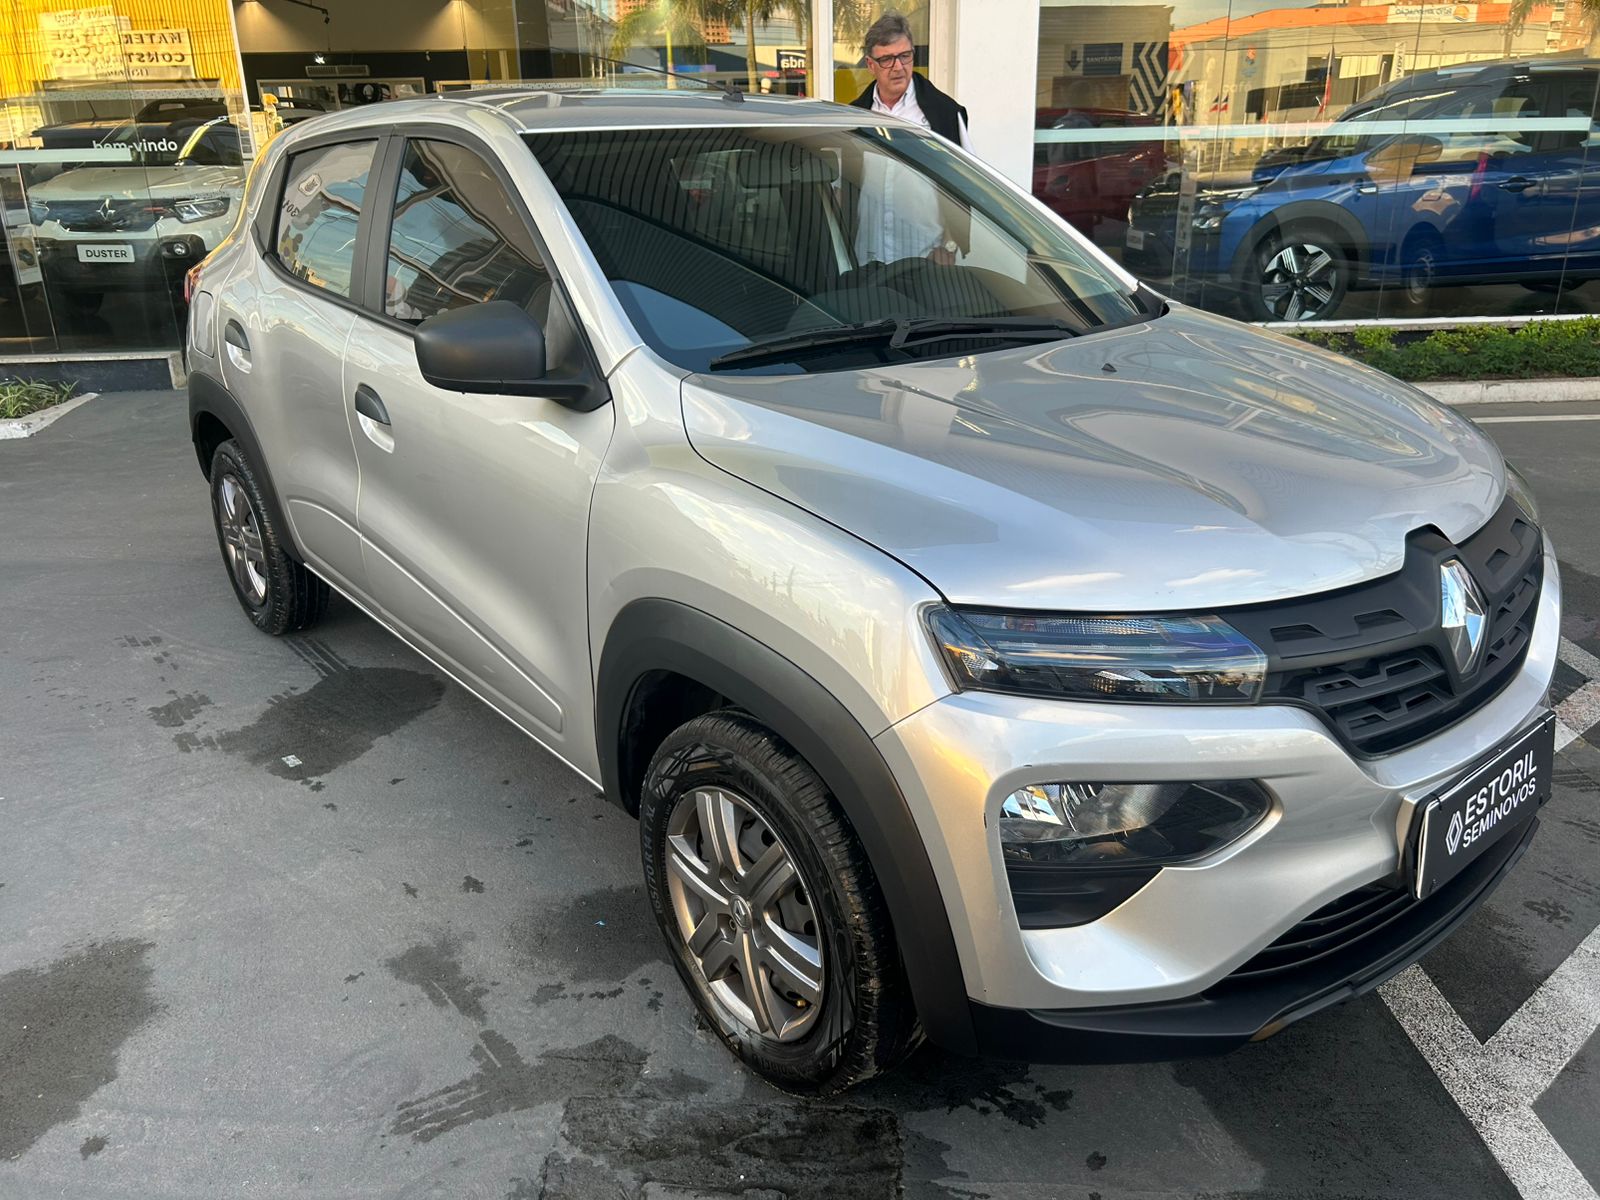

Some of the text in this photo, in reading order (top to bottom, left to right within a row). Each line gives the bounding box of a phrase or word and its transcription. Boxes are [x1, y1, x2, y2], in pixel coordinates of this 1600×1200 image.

[93, 138, 178, 151] bem-vindo
[85, 249, 128, 259] DUSTER
[1465, 750, 1537, 825] ESTORIL
[1463, 777, 1536, 848] SEMINOVOS
